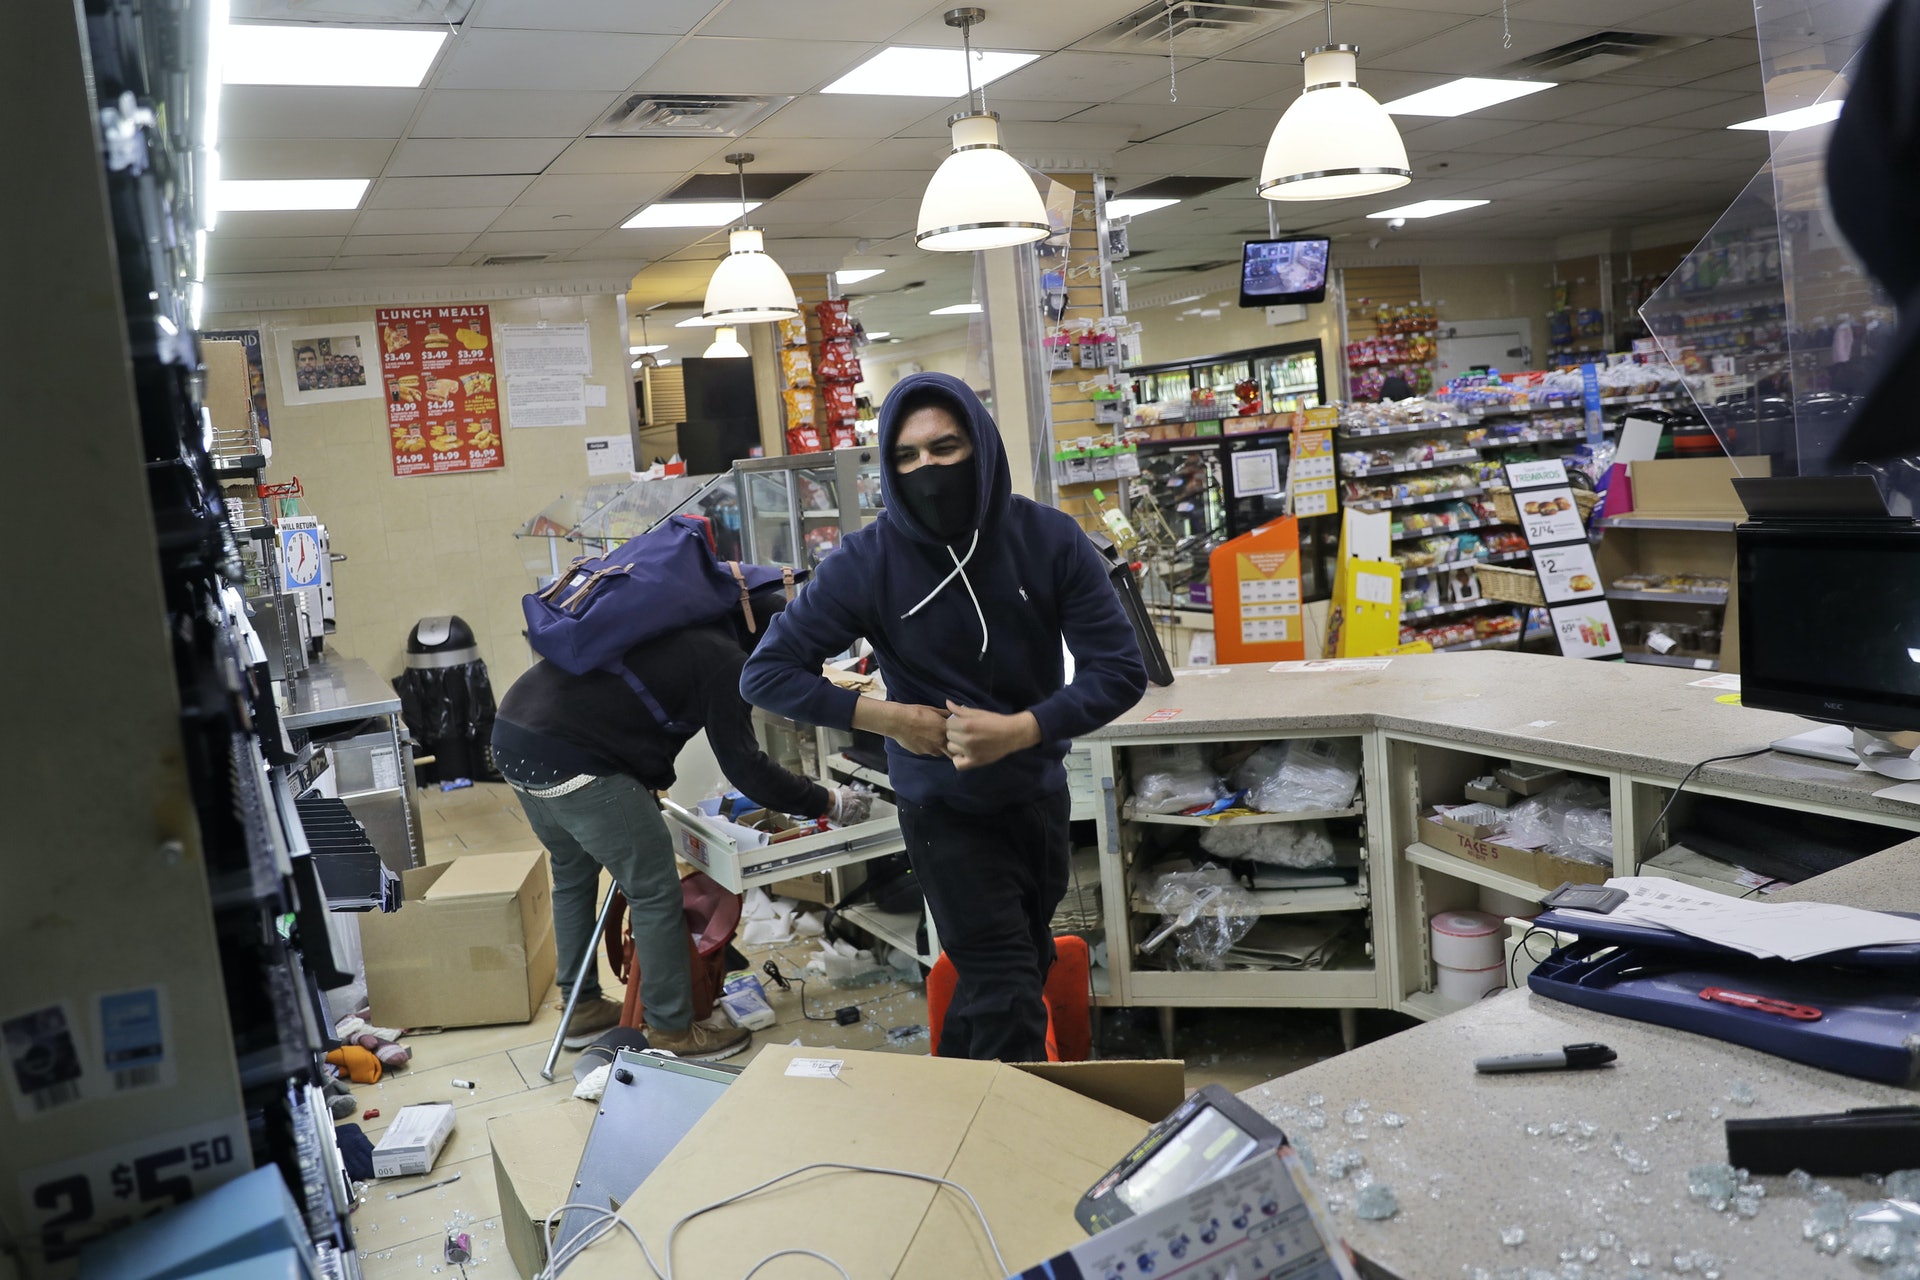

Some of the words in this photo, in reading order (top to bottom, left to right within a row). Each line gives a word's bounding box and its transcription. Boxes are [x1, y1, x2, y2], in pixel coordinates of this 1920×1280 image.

[381, 309, 432, 320] LUNCH
[439, 307, 485, 317] MEALS
[384, 352, 411, 362] $3.49
[421, 350, 448, 360] $3.49
[457, 349, 484, 359] $3.99
[390, 402, 417, 413] $3.99
[427, 400, 454, 410] $4.49
[396, 454, 423, 464] $4.99
[432, 451, 460, 461] $4.99
[281, 523, 296, 531] WILL
[295, 522, 317, 530] RETURN
[1823, 702, 1844, 710] NEC
[1457, 833, 1488, 856] TAKE
